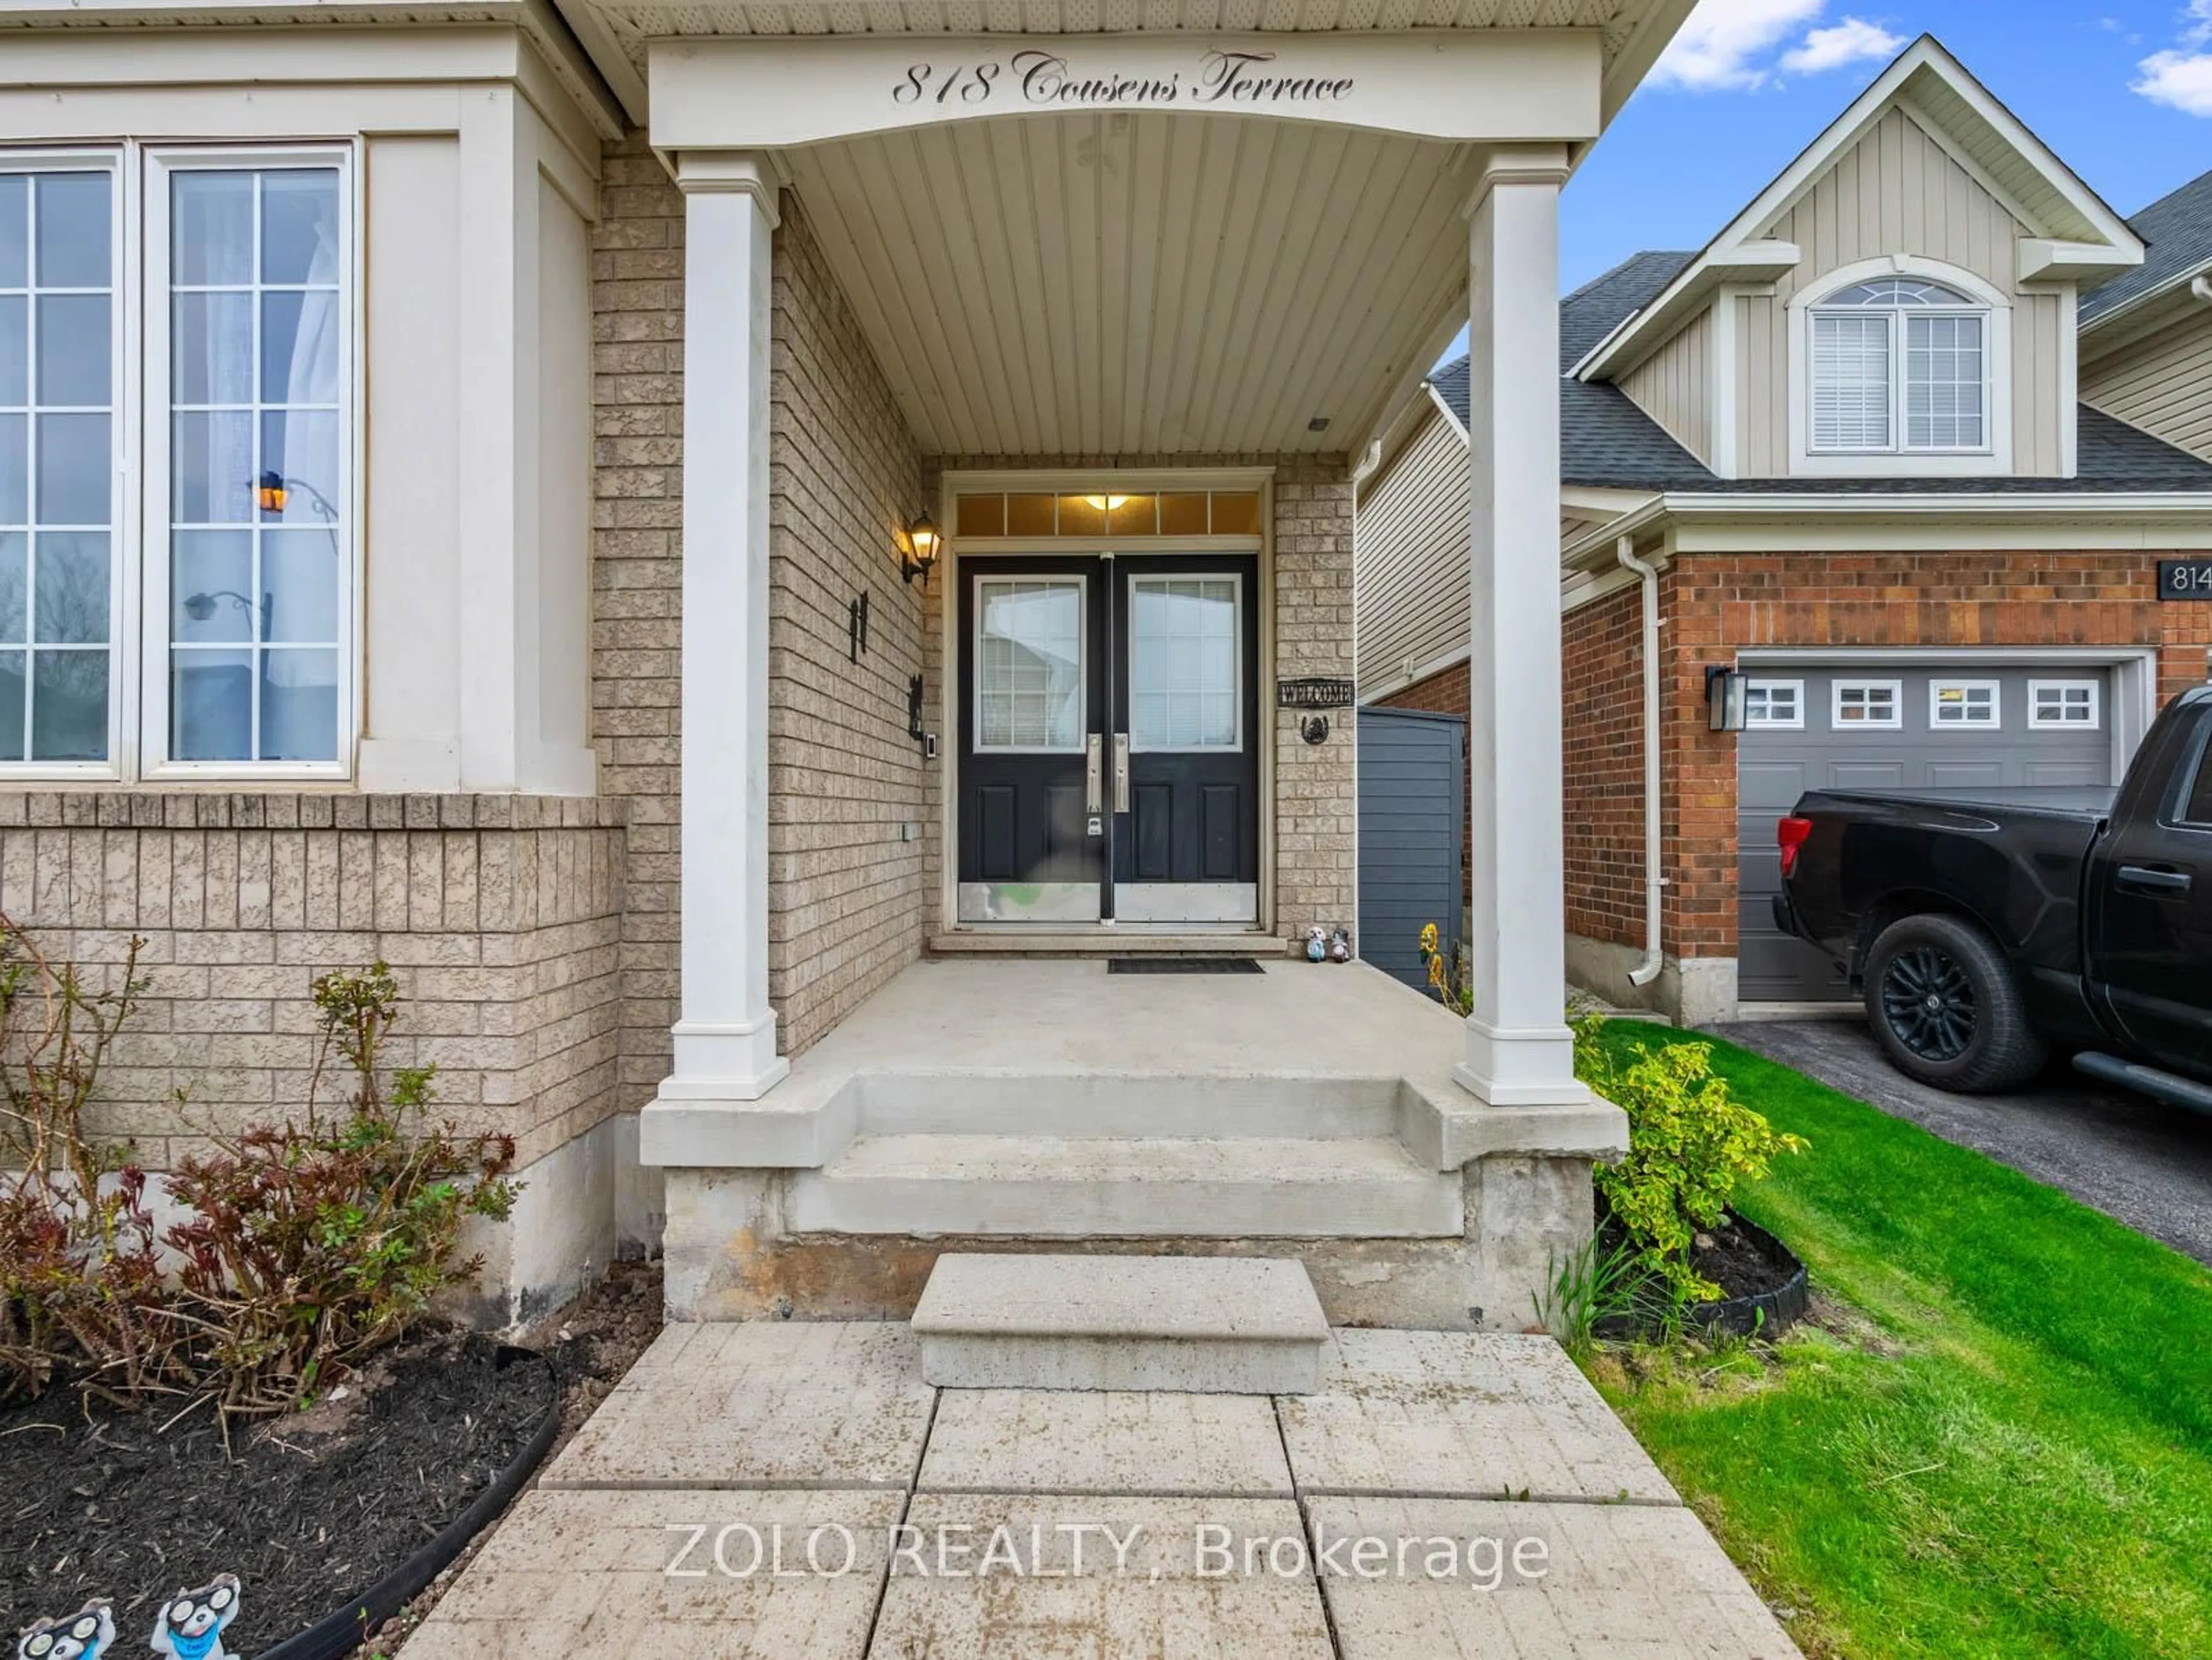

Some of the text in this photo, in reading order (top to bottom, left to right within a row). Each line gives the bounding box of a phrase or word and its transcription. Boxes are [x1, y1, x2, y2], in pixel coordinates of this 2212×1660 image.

[893, 48, 1354, 104] 818 Cousens Terrace
[2174, 567, 2212, 590] 814
[1281, 685, 1351, 702] WELCOME
